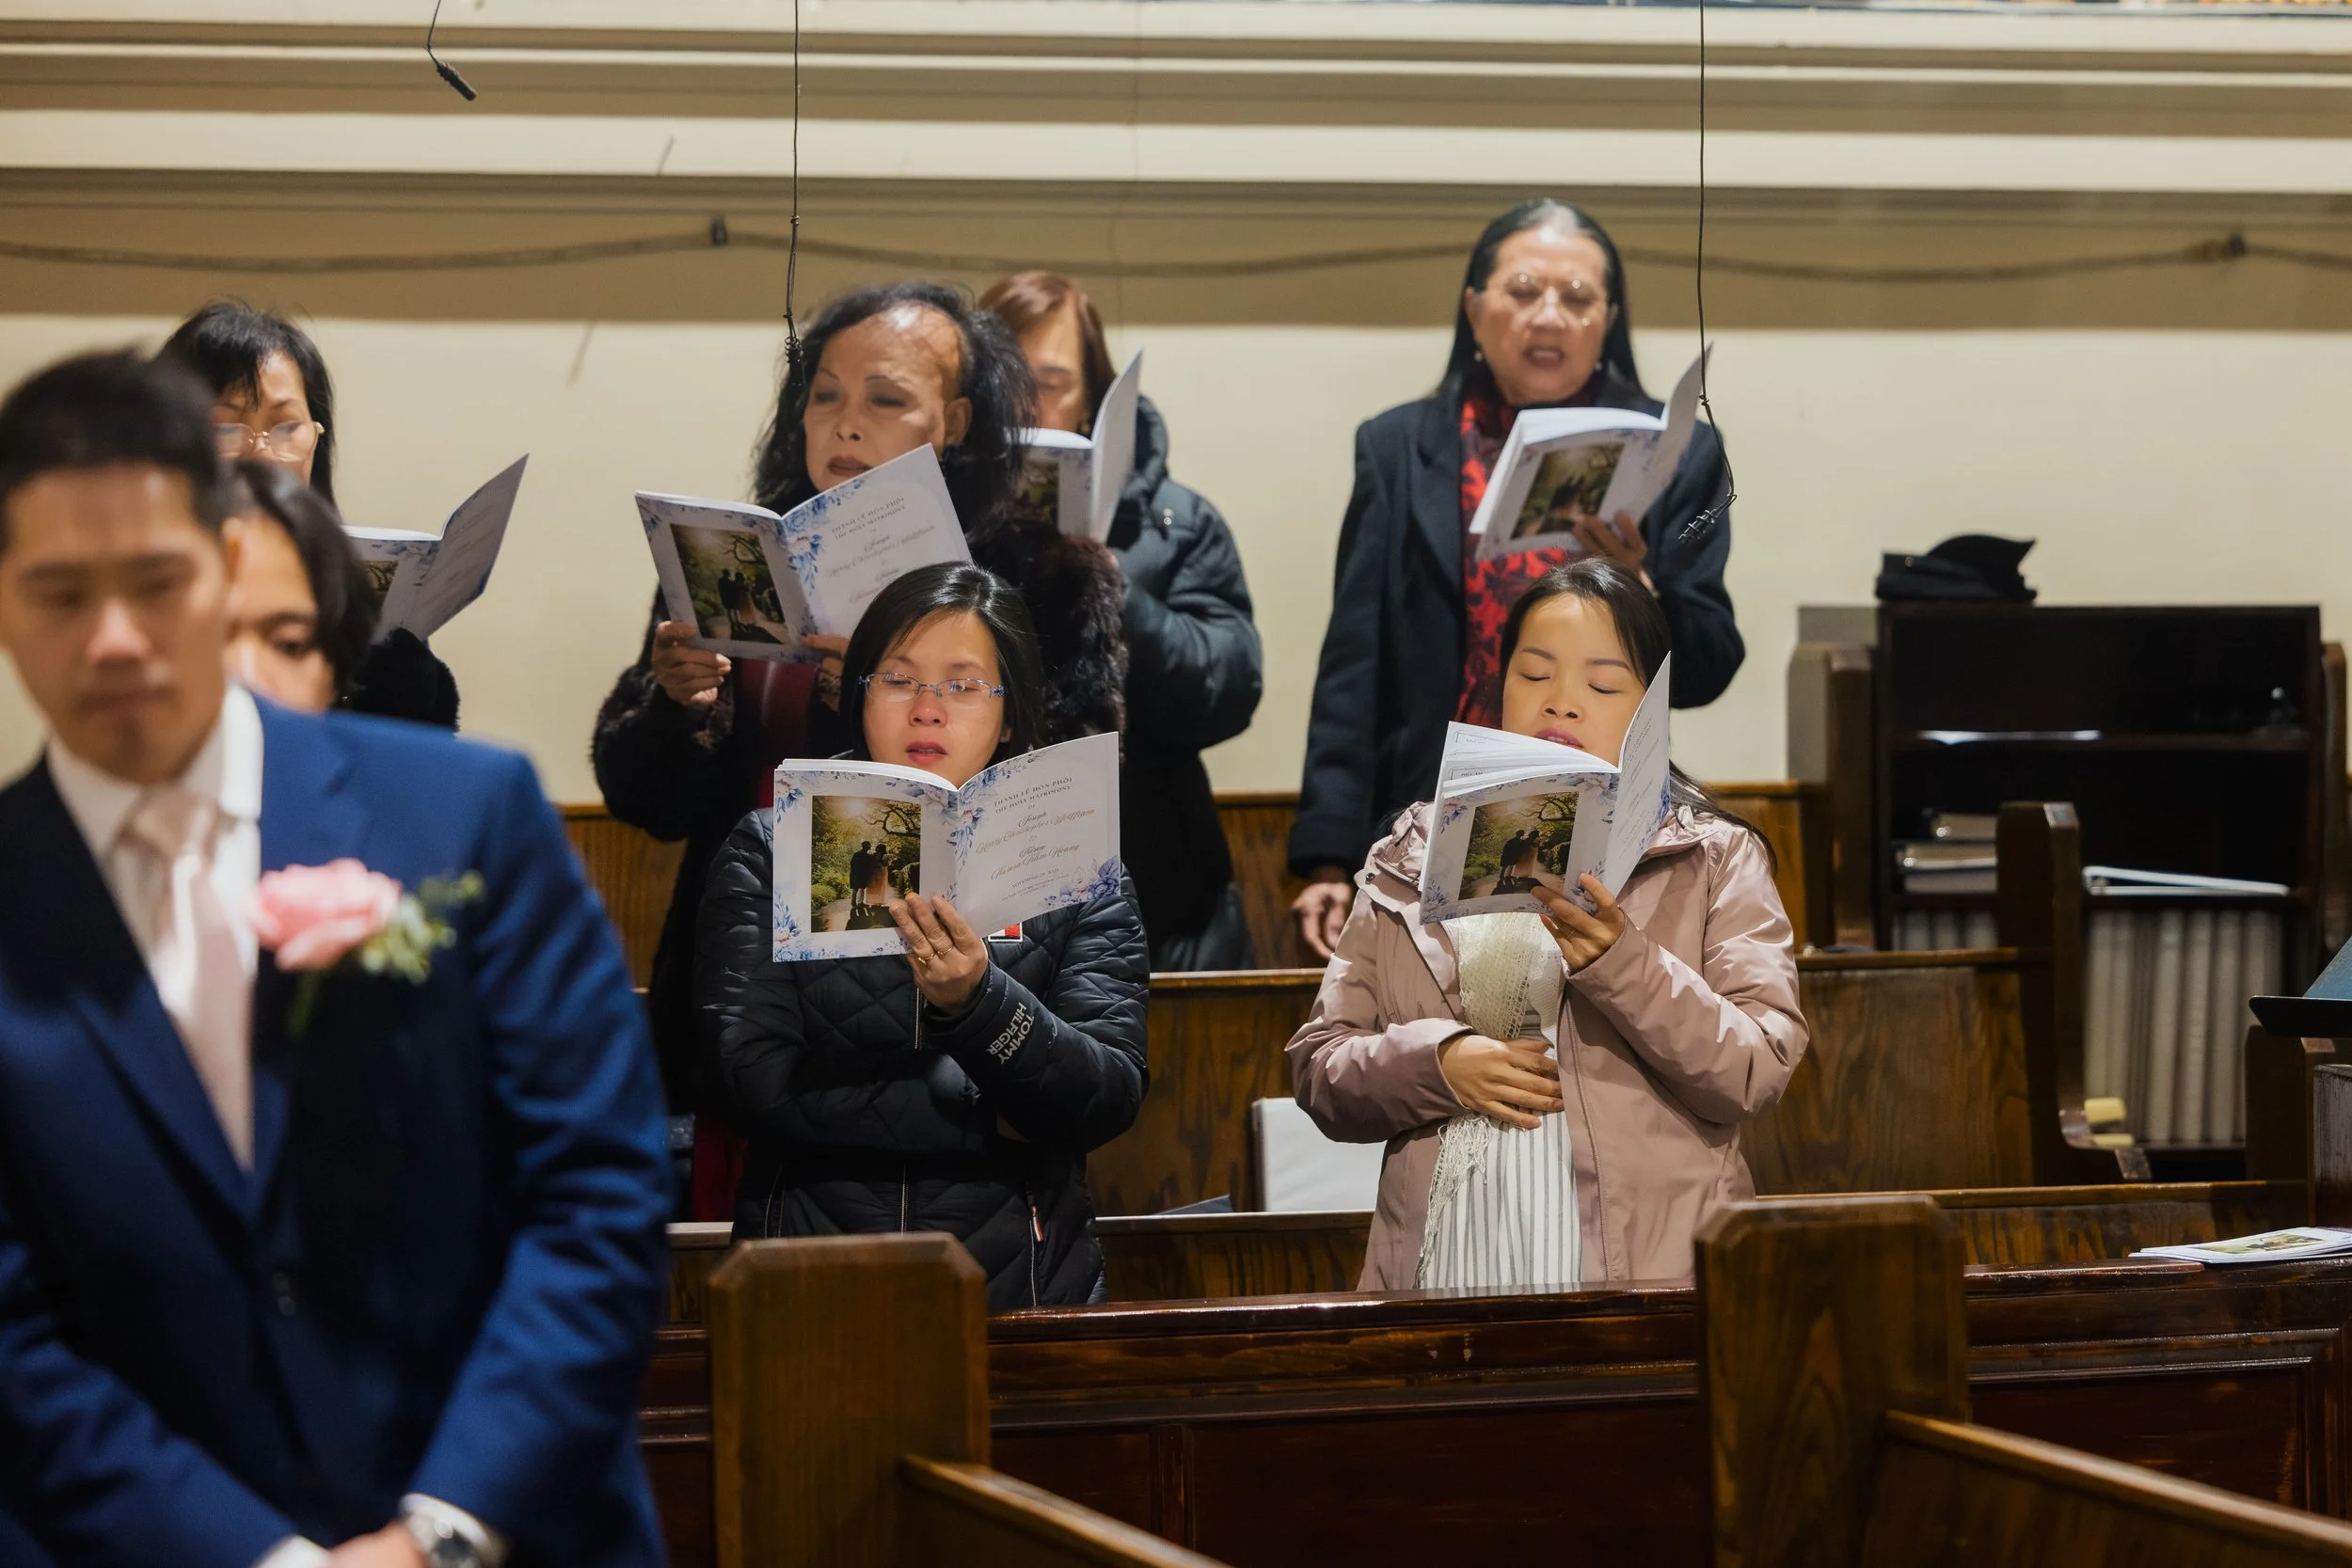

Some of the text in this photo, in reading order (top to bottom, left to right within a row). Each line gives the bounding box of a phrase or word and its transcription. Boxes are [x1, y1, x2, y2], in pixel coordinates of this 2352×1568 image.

[995, 785, 1072, 814] THE HOLY MATRIMONY
[985, 1002, 1027, 1055] HILFIGER
[998, 1015, 1034, 1064] TOMMY
